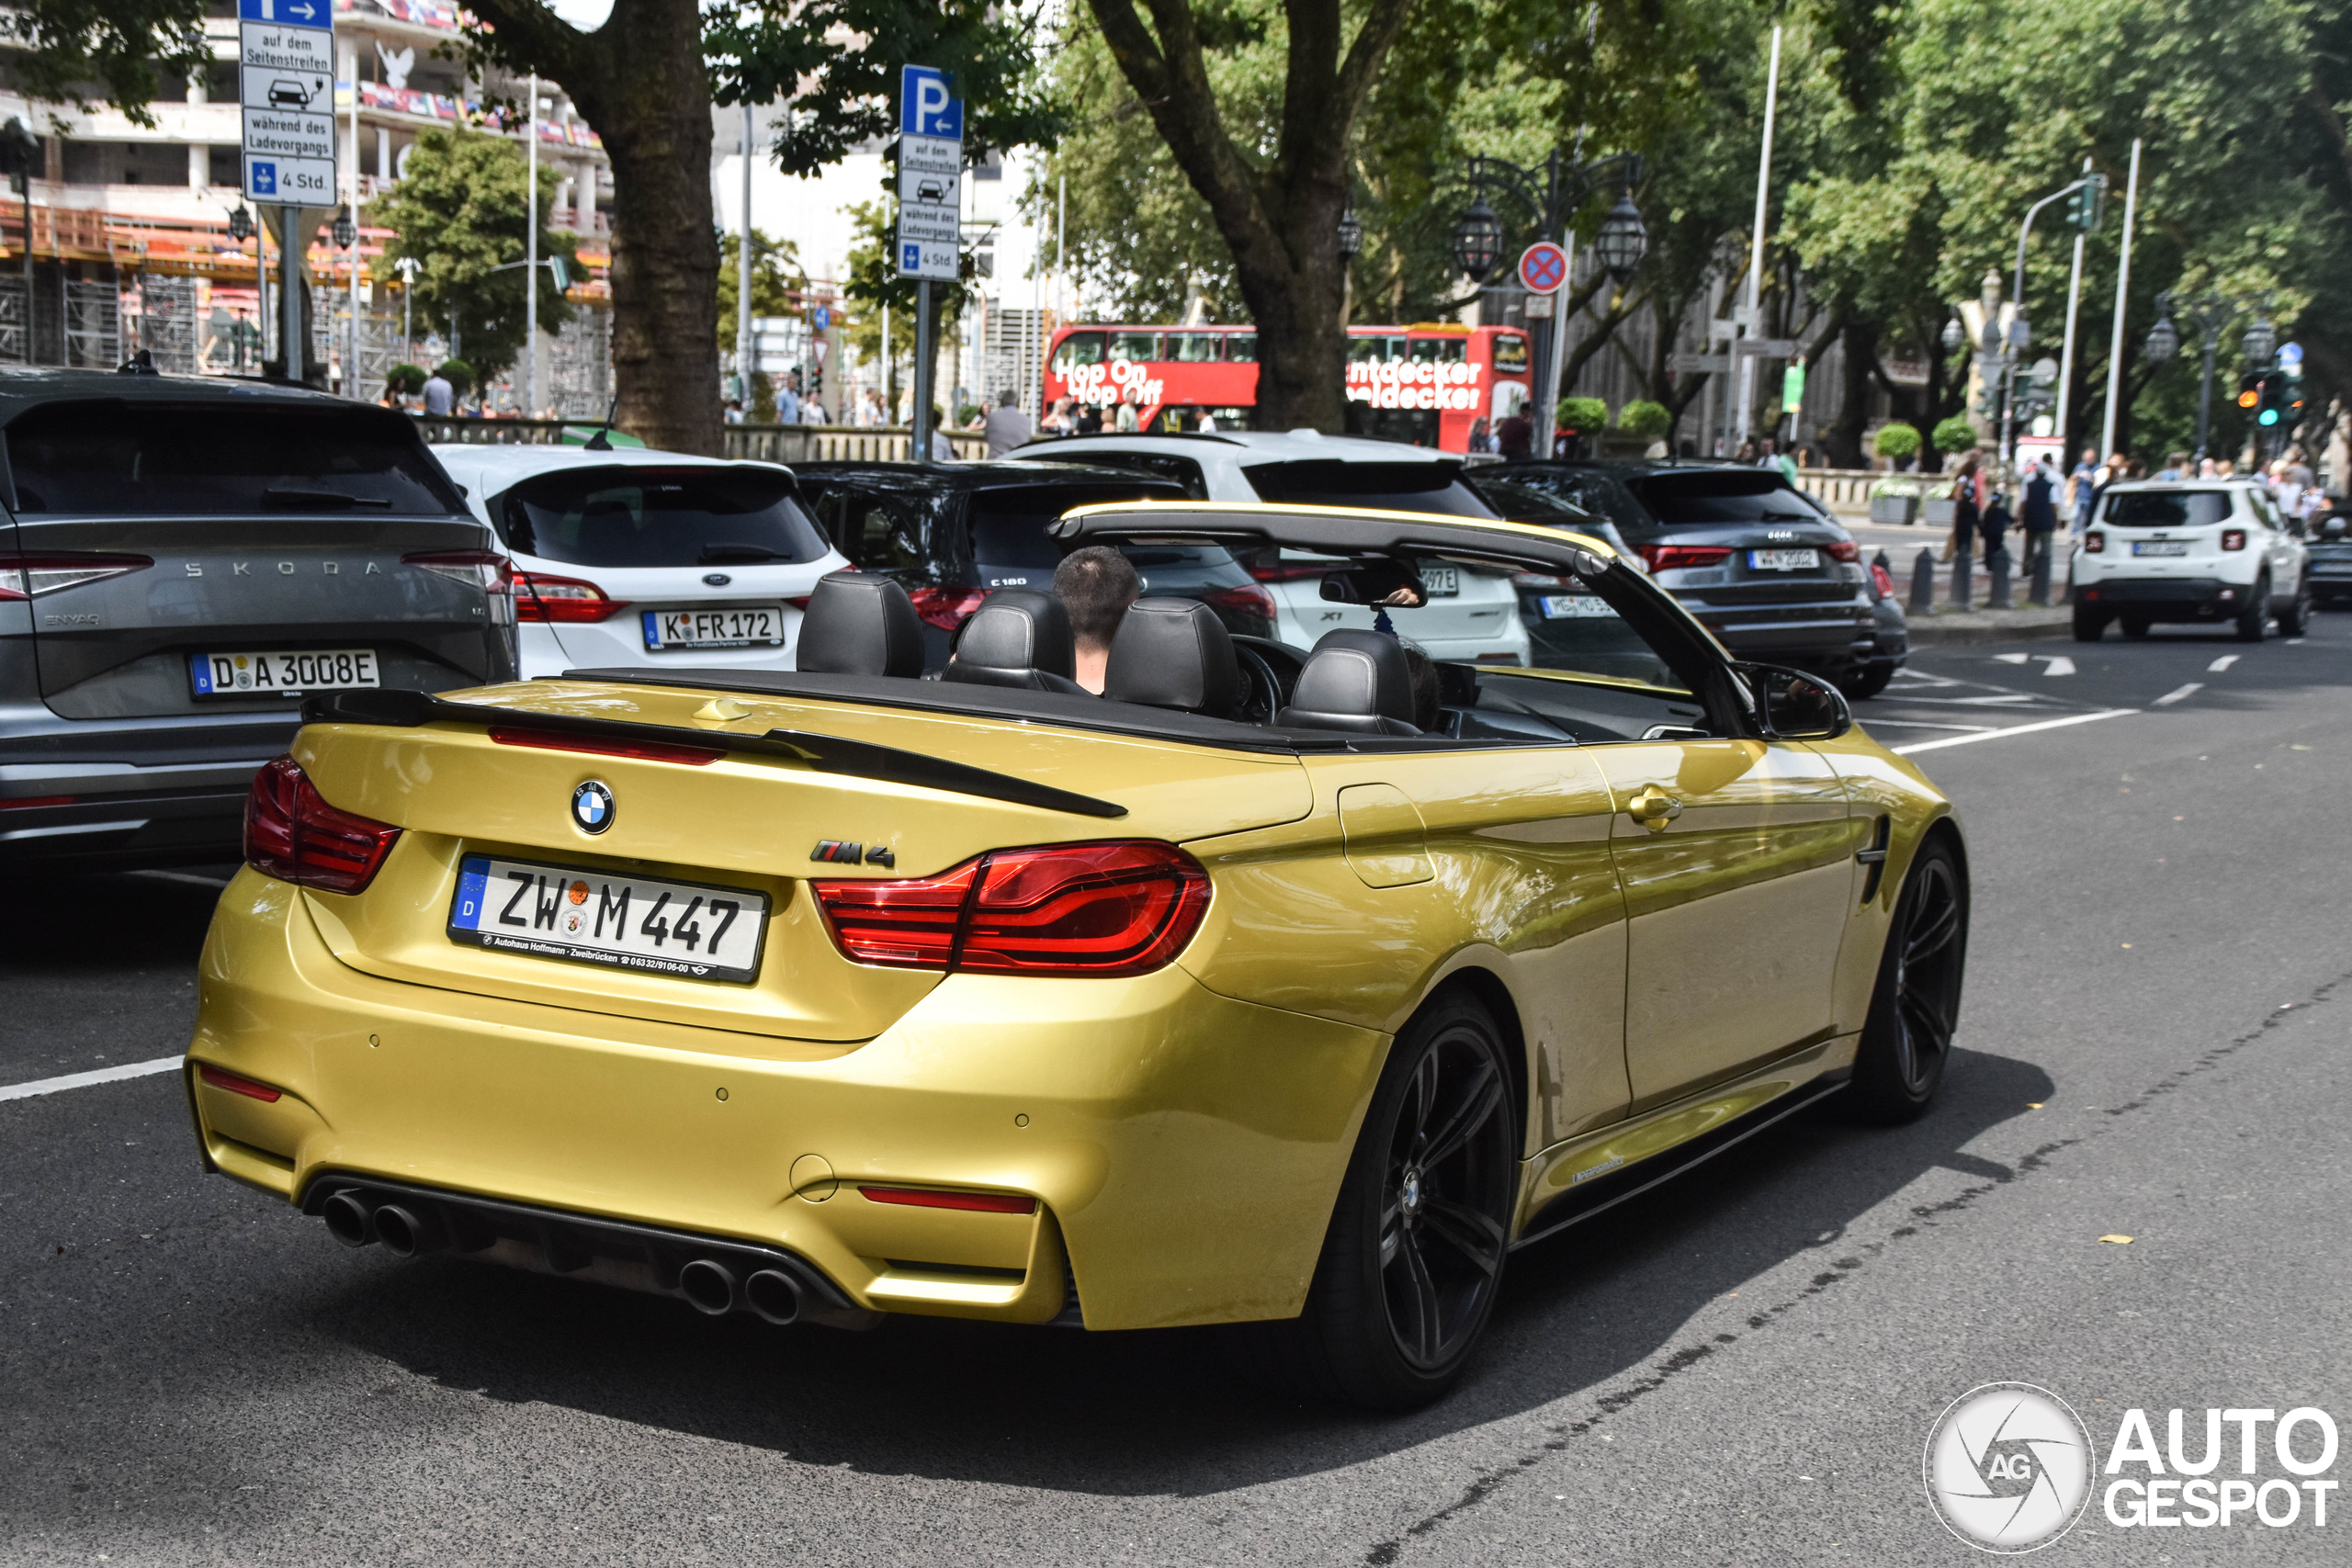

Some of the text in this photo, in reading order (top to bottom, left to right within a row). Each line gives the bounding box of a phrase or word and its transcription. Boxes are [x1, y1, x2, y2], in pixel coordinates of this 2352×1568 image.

[263, 35, 312, 50] auf dem
[247, 49, 328, 70] Seitenstreifen
[916, 77, 949, 133] P
[252, 116, 326, 134] während des
[249, 134, 329, 156] Ladevorgangs
[916, 145, 948, 156] auf dem
[282, 173, 328, 189] 4 Std.
[905, 209, 954, 222] während des
[903, 223, 955, 239] Ladevorgangs
[922, 253, 953, 267] 4 Std.
[1056, 358, 1147, 388] Hop On
[1346, 355, 1482, 384] ntdecker
[1069, 379, 1163, 409] Hop Off
[186, 561, 380, 577] SKODA
[1001, 578, 1027, 586] 180
[45, 615, 99, 626] ENYAQ
[666, 615, 681, 639] K
[696, 614, 726, 638] FR
[730, 613, 771, 637] 172
[1320, 612, 1342, 621] X1
[199, 653, 375, 688] D D A 3008E
[576, 782, 610, 803] BMW
[462, 900, 475, 917] D
[499, 871, 566, 931] ZW
[594, 885, 631, 941] M
[640, 892, 741, 954] 447
[494, 938, 529, 950] Autohaus
[530, 942, 565, 955] Hoffmann
[571, 949, 618, 964] Zweibrücken
